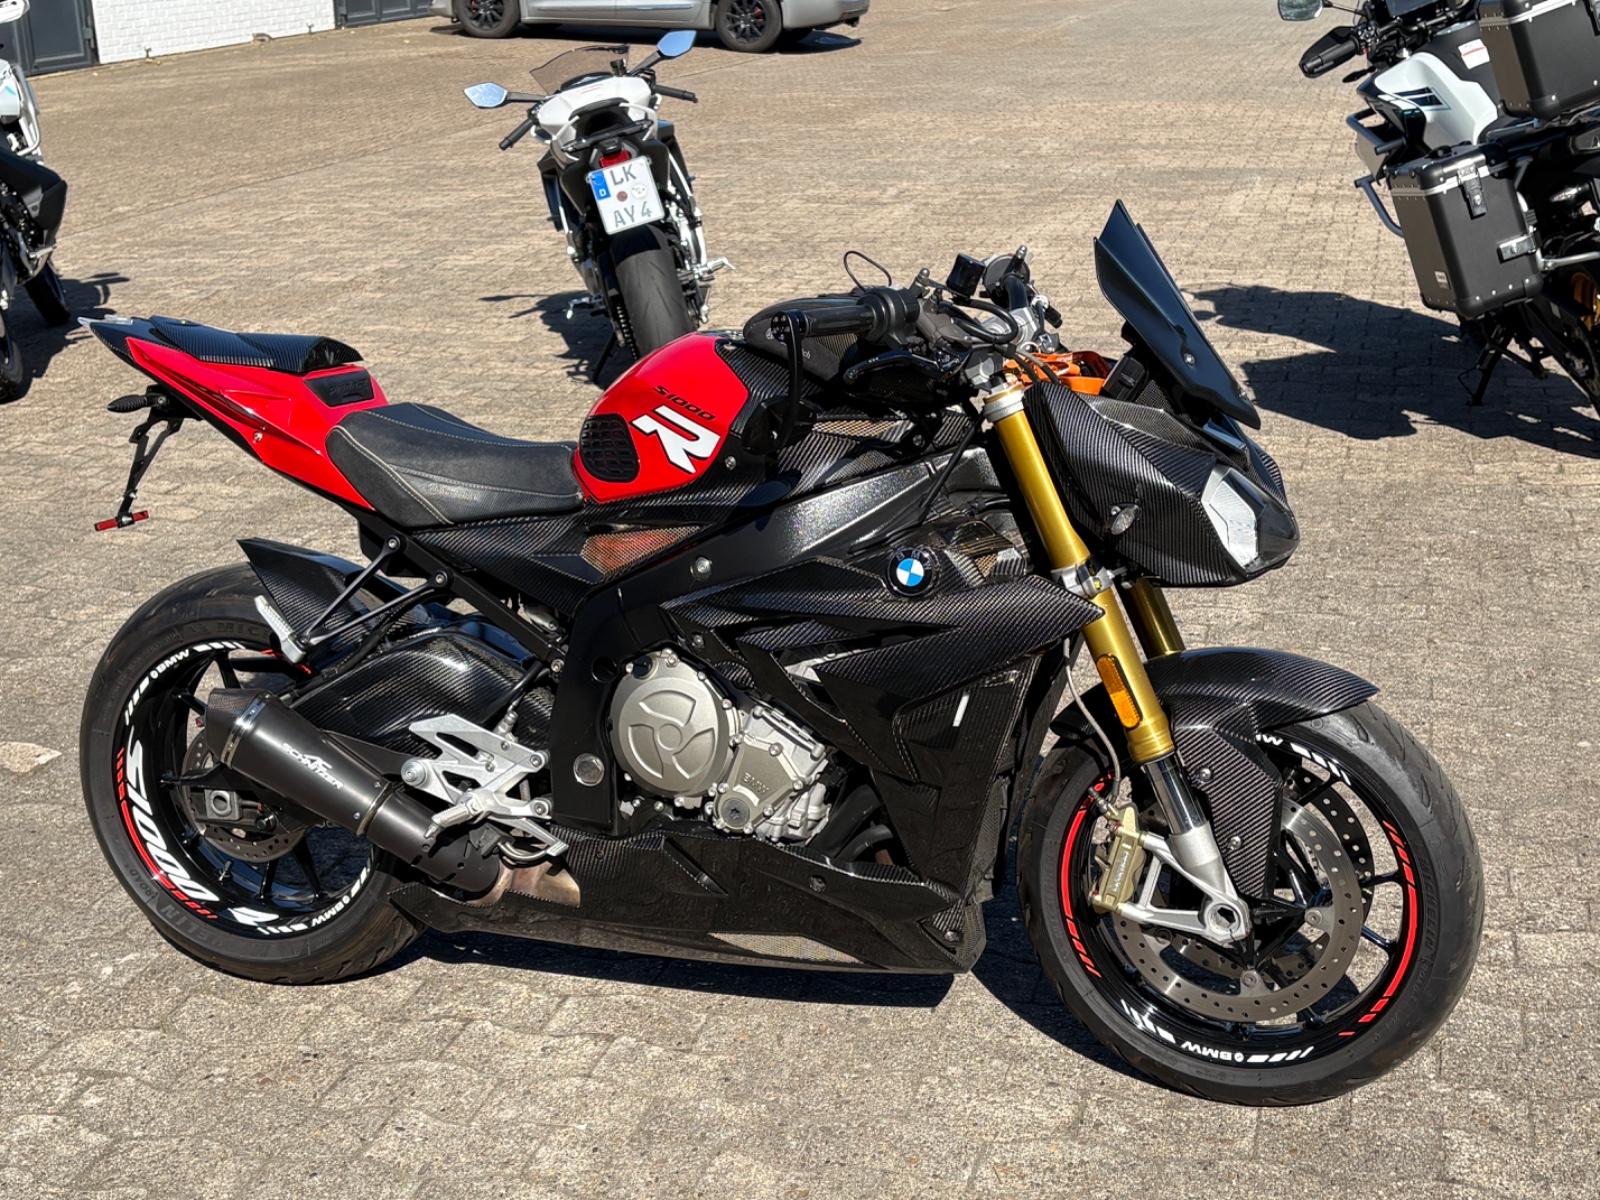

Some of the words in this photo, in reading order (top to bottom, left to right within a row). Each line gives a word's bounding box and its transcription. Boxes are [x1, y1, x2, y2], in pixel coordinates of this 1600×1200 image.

[609, 163, 637, 186] LK
[613, 204, 636, 228] AY
[641, 200, 653, 218] 4
[653, 385, 716, 421] S1000
[630, 405, 721, 475] R
[157, 649, 190, 674] BMW
[126, 725, 220, 901] S1000
[311, 901, 345, 927] BMW
[1181, 1040, 1232, 1061] BMW
